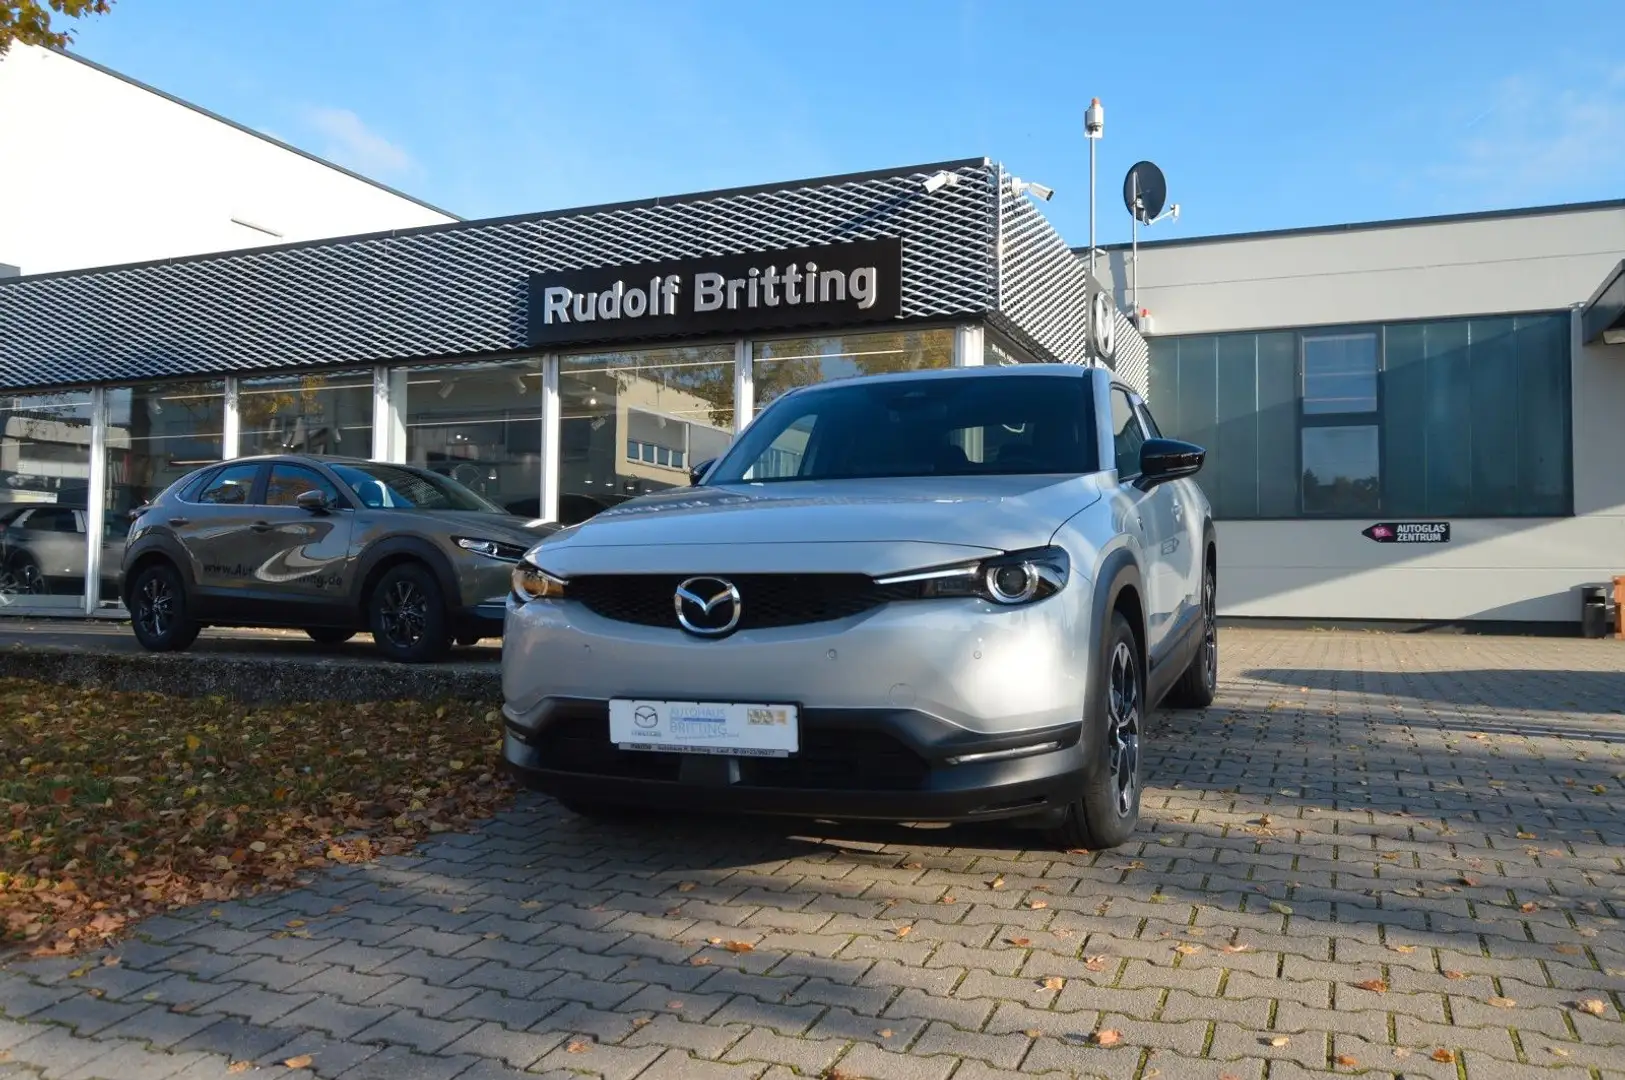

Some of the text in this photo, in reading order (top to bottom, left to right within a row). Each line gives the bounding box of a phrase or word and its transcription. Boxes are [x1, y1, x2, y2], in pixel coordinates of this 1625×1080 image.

[543, 261, 877, 325] Rudolf Britting
[1396, 524, 1446, 533] AUTOGLAS
[1397, 533, 1441, 541] ZENTRUM
[669, 707, 726, 718] AUTOHAUS
[669, 721, 728, 735] BRITTING
